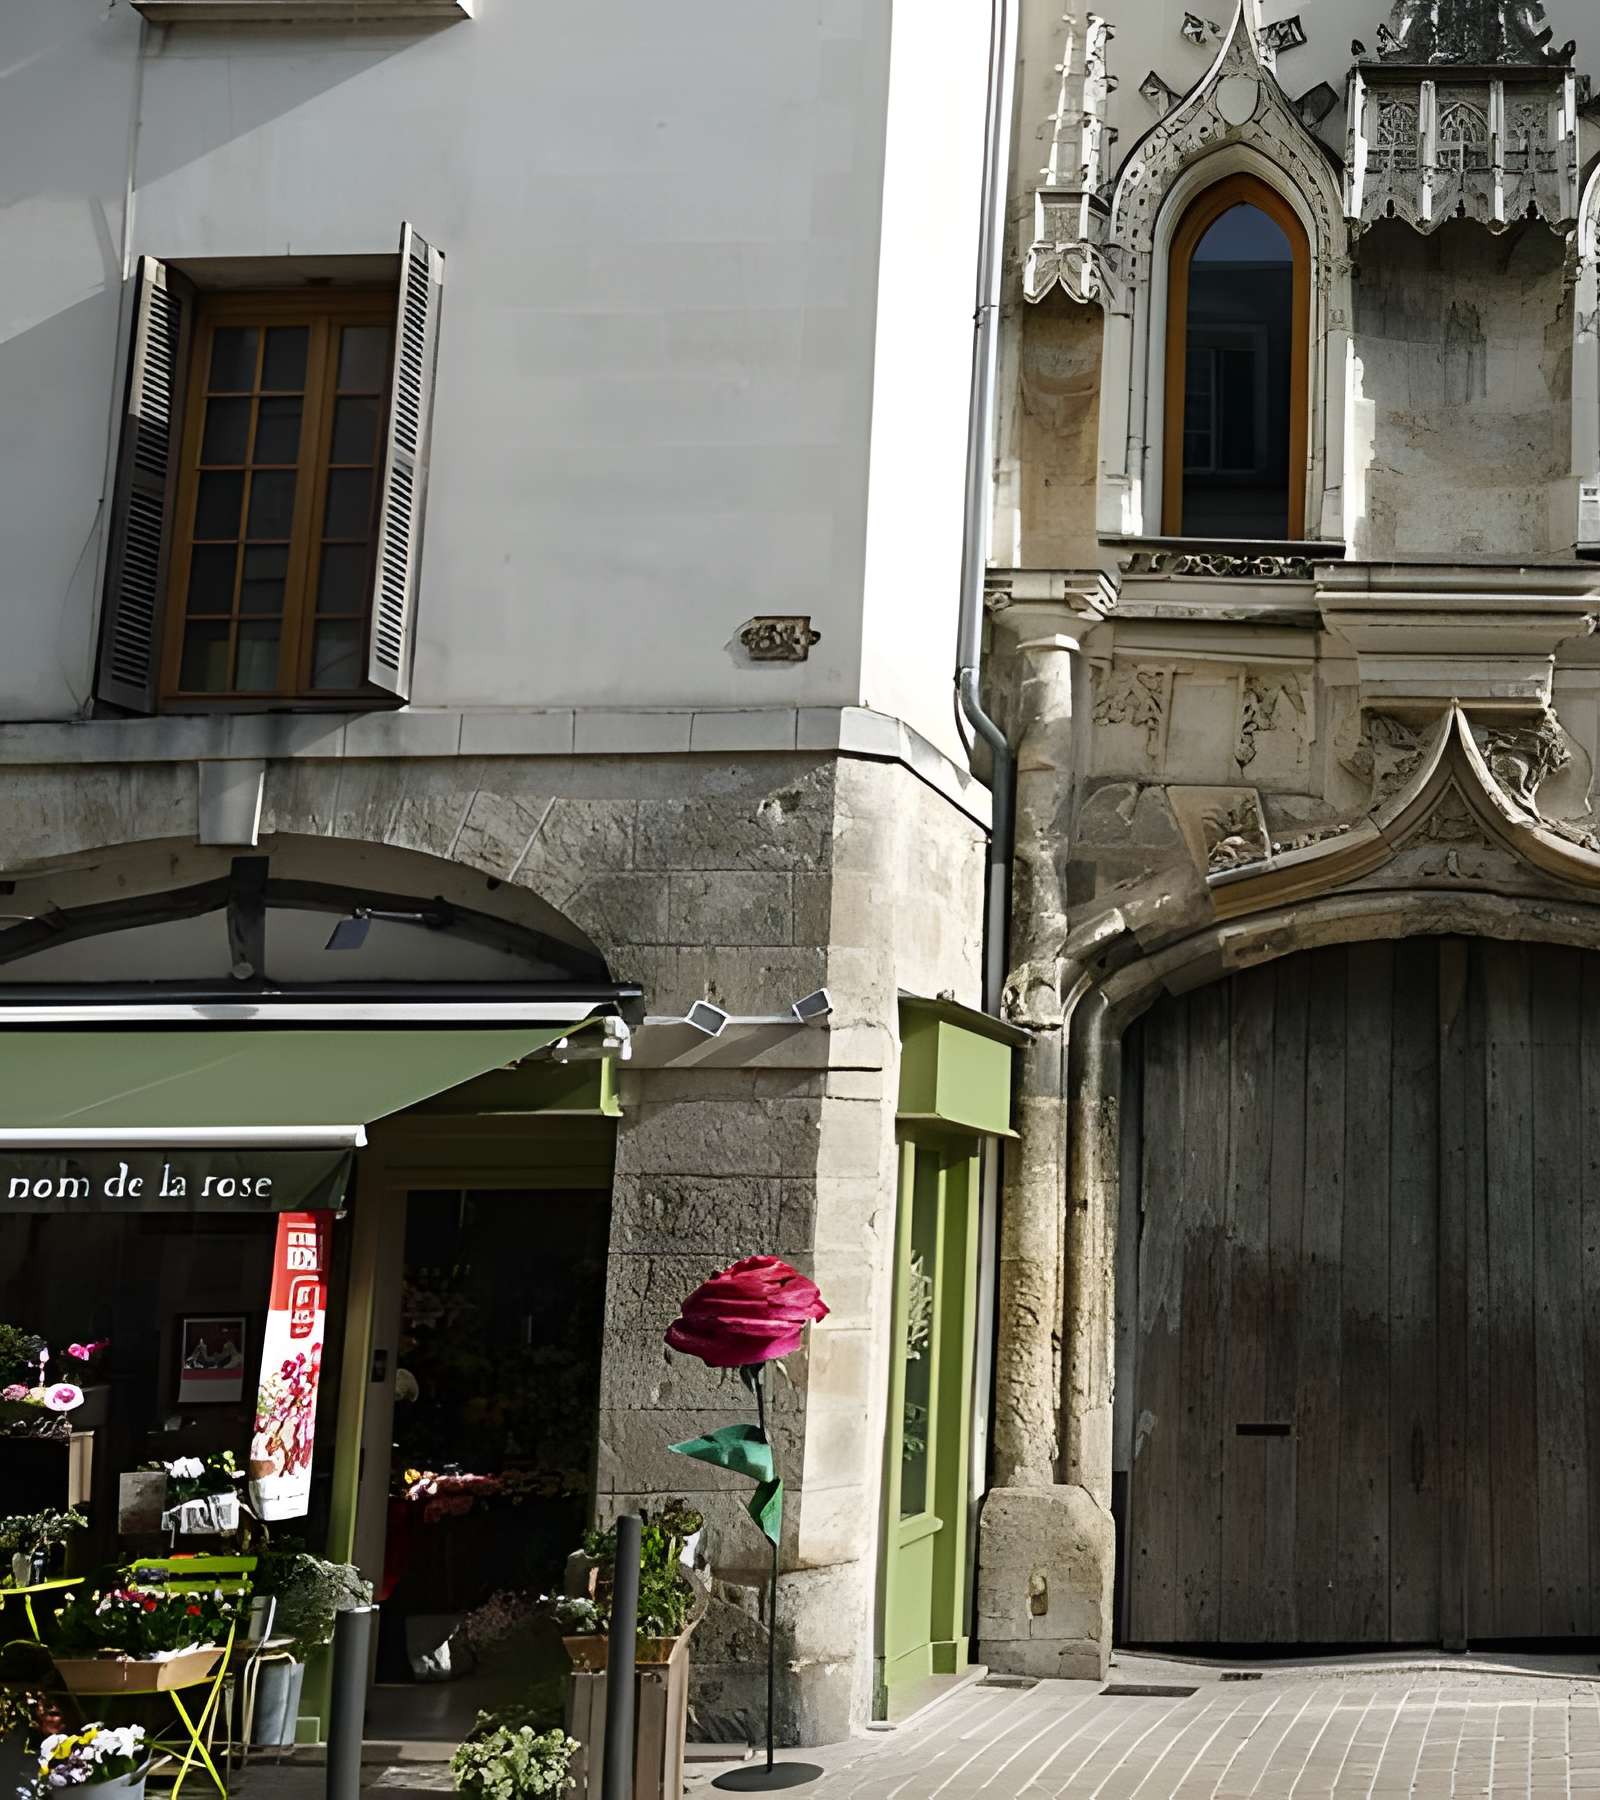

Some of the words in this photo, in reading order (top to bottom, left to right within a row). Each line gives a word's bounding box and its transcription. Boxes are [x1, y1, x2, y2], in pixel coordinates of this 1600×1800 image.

[8, 1177, 90, 1198] nom
[104, 1162, 144, 1197] de
[159, 1163, 187, 1197] la
[201, 1176, 273, 1198] rose
